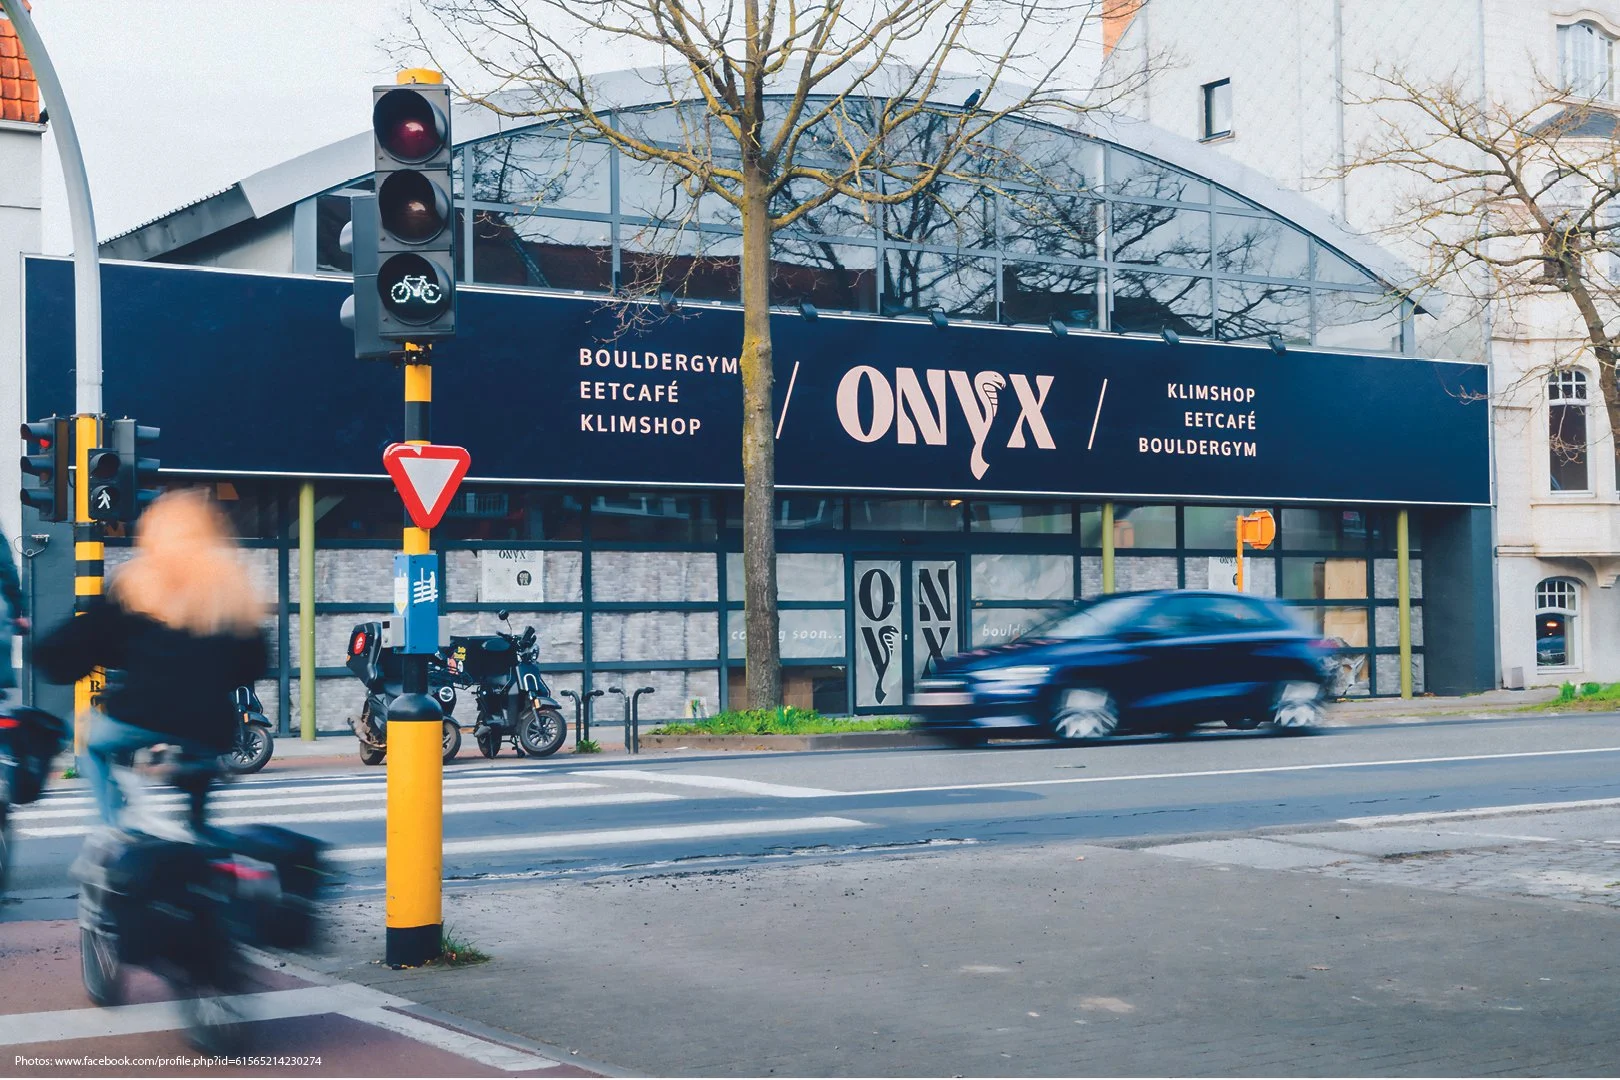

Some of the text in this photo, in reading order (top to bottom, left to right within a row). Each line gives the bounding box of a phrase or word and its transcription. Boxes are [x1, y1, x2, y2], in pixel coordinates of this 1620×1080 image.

[579, 348, 738, 375] BOULDERGYM
[580, 380, 679, 403] EETCAFÉ
[1167, 382, 1256, 403] KLIMSHOP
[580, 413, 702, 436] KLIMSHOP
[836, 365, 1057, 481] ONYX
[1184, 411, 1256, 430] EETCAFÉ
[1138, 437, 1257, 457] BOULDERGYM
[731, 629, 843, 643] cog soon...
